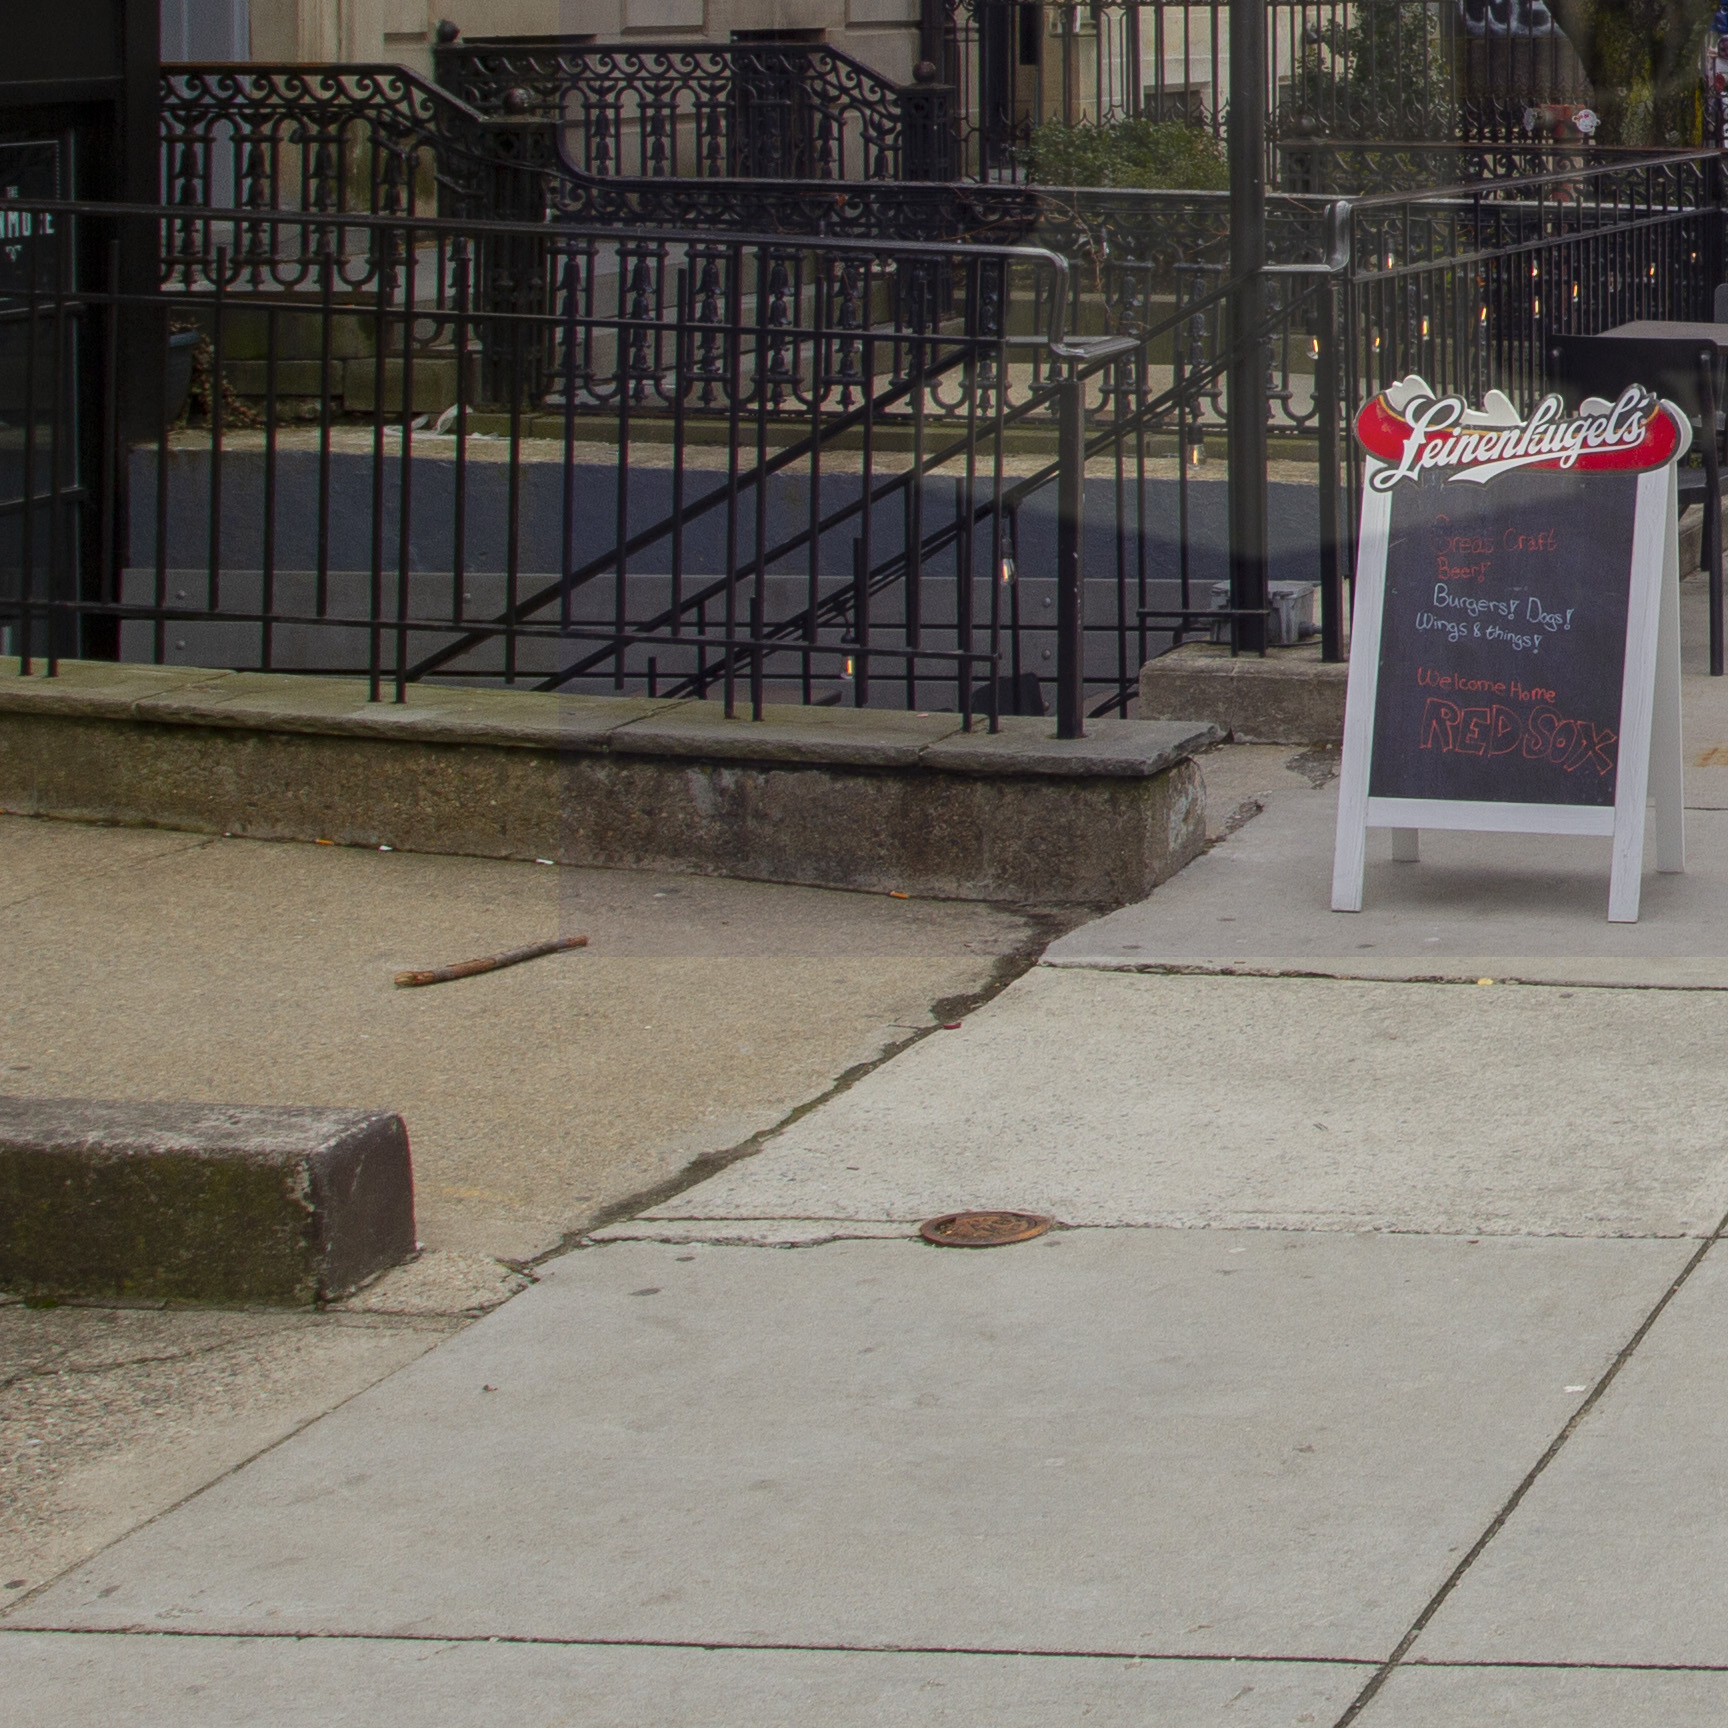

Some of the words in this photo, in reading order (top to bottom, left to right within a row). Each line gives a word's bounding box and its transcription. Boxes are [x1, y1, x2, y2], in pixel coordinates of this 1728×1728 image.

[1373, 388, 1650, 489] Leinenkugel's
[1503, 528, 1558, 552] Craft
[1436, 556, 1492, 583] Beer!
[1433, 583, 1519, 620] Burgers!
[1526, 597, 1575, 632] Dogs!
[1415, 613, 1468, 642] Wings
[1485, 626, 1543, 654] things!
[1417, 667, 1506, 696] Welcome
[1510, 681, 1557, 703] Home
[1419, 697, 1523, 758] RED
[1523, 704, 1618, 775] SOX
